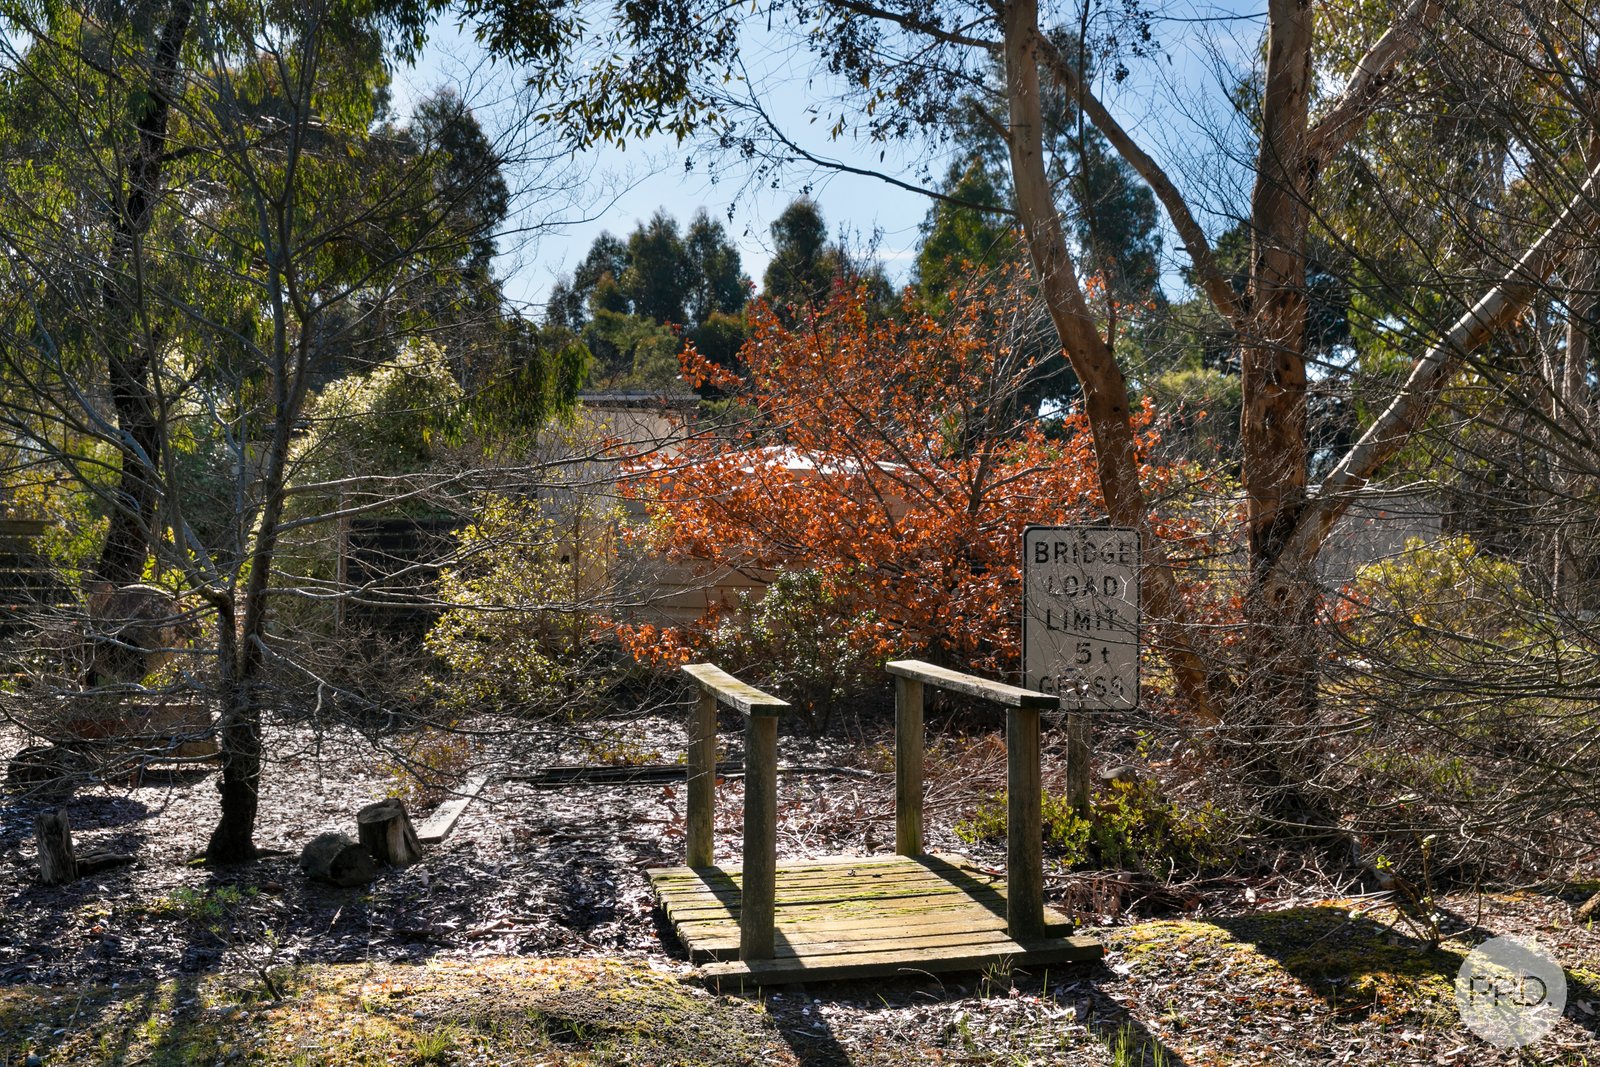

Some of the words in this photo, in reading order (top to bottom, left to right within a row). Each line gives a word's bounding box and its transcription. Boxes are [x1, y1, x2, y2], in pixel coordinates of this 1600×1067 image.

[1034, 541, 1132, 564] BRIDGE
[1048, 575, 1118, 598] LOAD
[1046, 608, 1118, 631] LIMIT
[1075, 642, 1092, 665] 5
[1100, 646, 1111, 664] t
